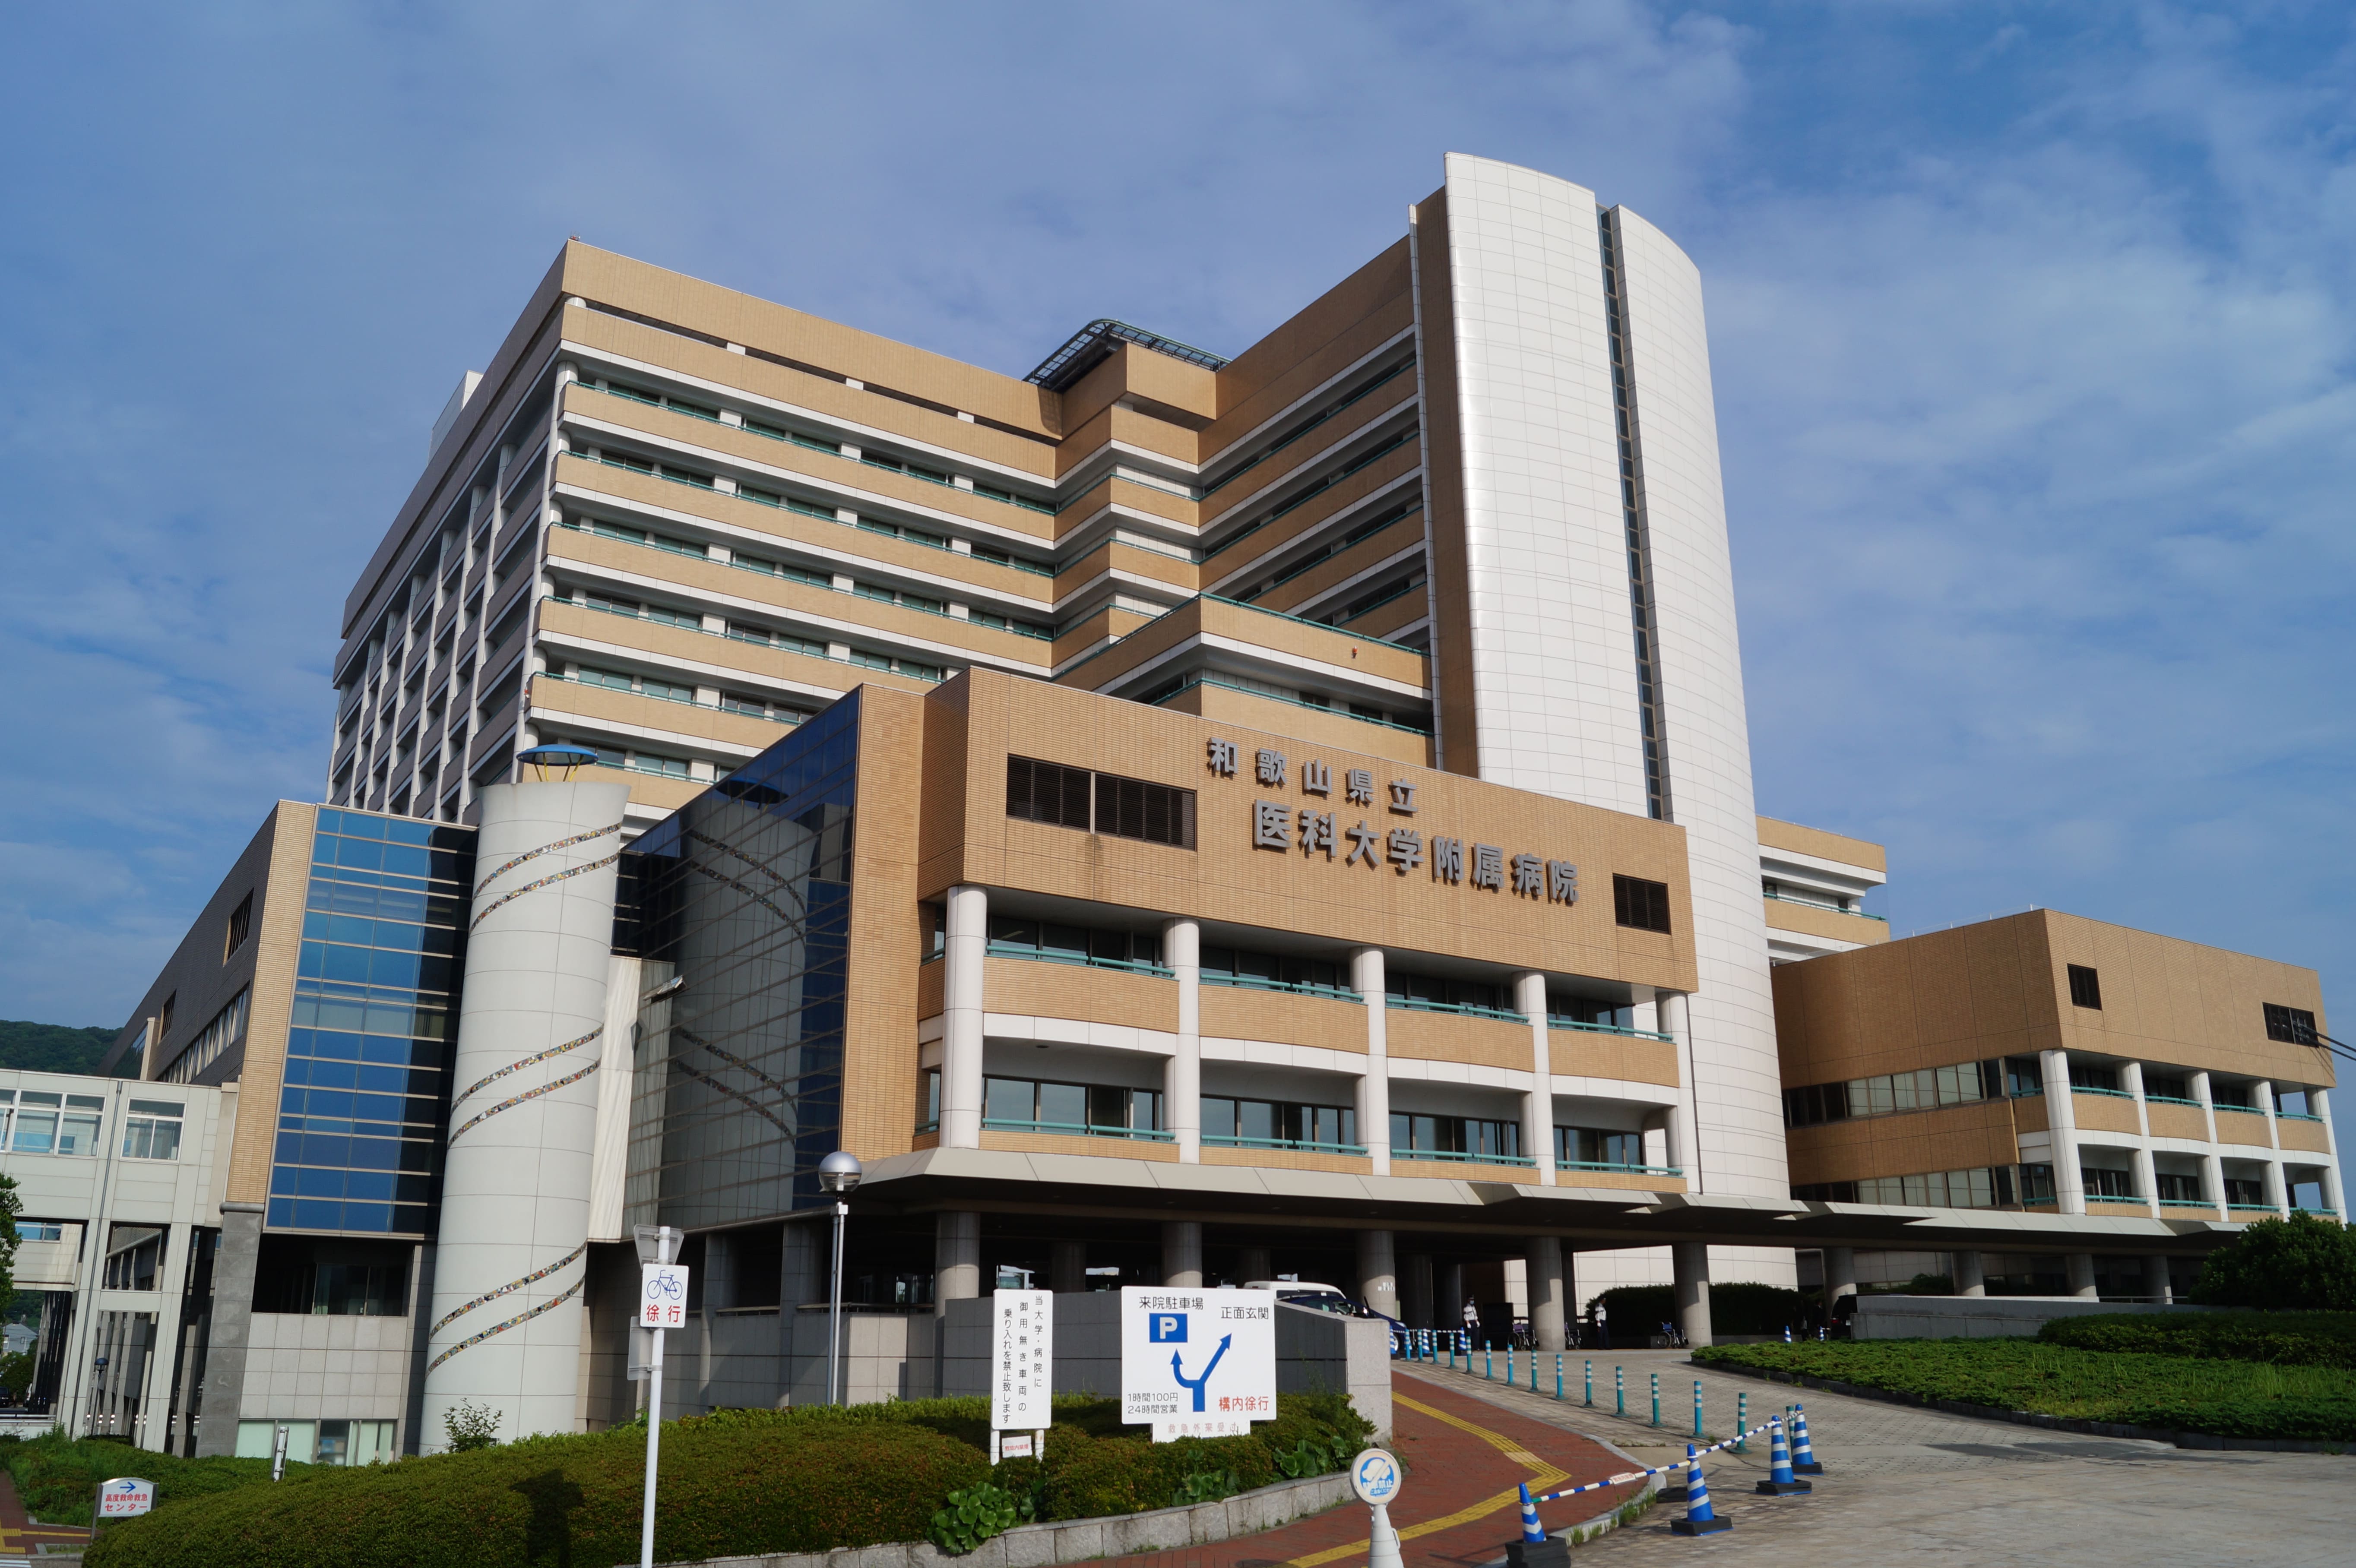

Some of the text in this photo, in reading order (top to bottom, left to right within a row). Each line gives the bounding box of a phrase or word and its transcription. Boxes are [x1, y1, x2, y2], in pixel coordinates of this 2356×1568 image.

[1209, 737, 1418, 813] 和歌山県立
[1254, 799, 1579, 902] 医科大学附属病院
[1139, 1296, 1204, 1310] 来院駐車場
[646, 1304, 681, 1322] 徐行
[1220, 1306, 1269, 1320] 正面玄関
[1159, 1316, 1178, 1339] P
[1034, 1295, 1043, 1388] 当大学・病院に
[1018, 1302, 1028, 1412] 御用無き車両の
[1002, 1308, 1013, 1424] 乗り入れを禁止致します
[1127, 1392, 1178, 1402] 1時間100円
[1219, 1396, 1269, 1412] 構内徐行
[1127, 1404, 1178, 1414] 24時間営業
[105, 1493, 148, 1502] 高度救命救急
[104, 1503, 148, 1512] センター
